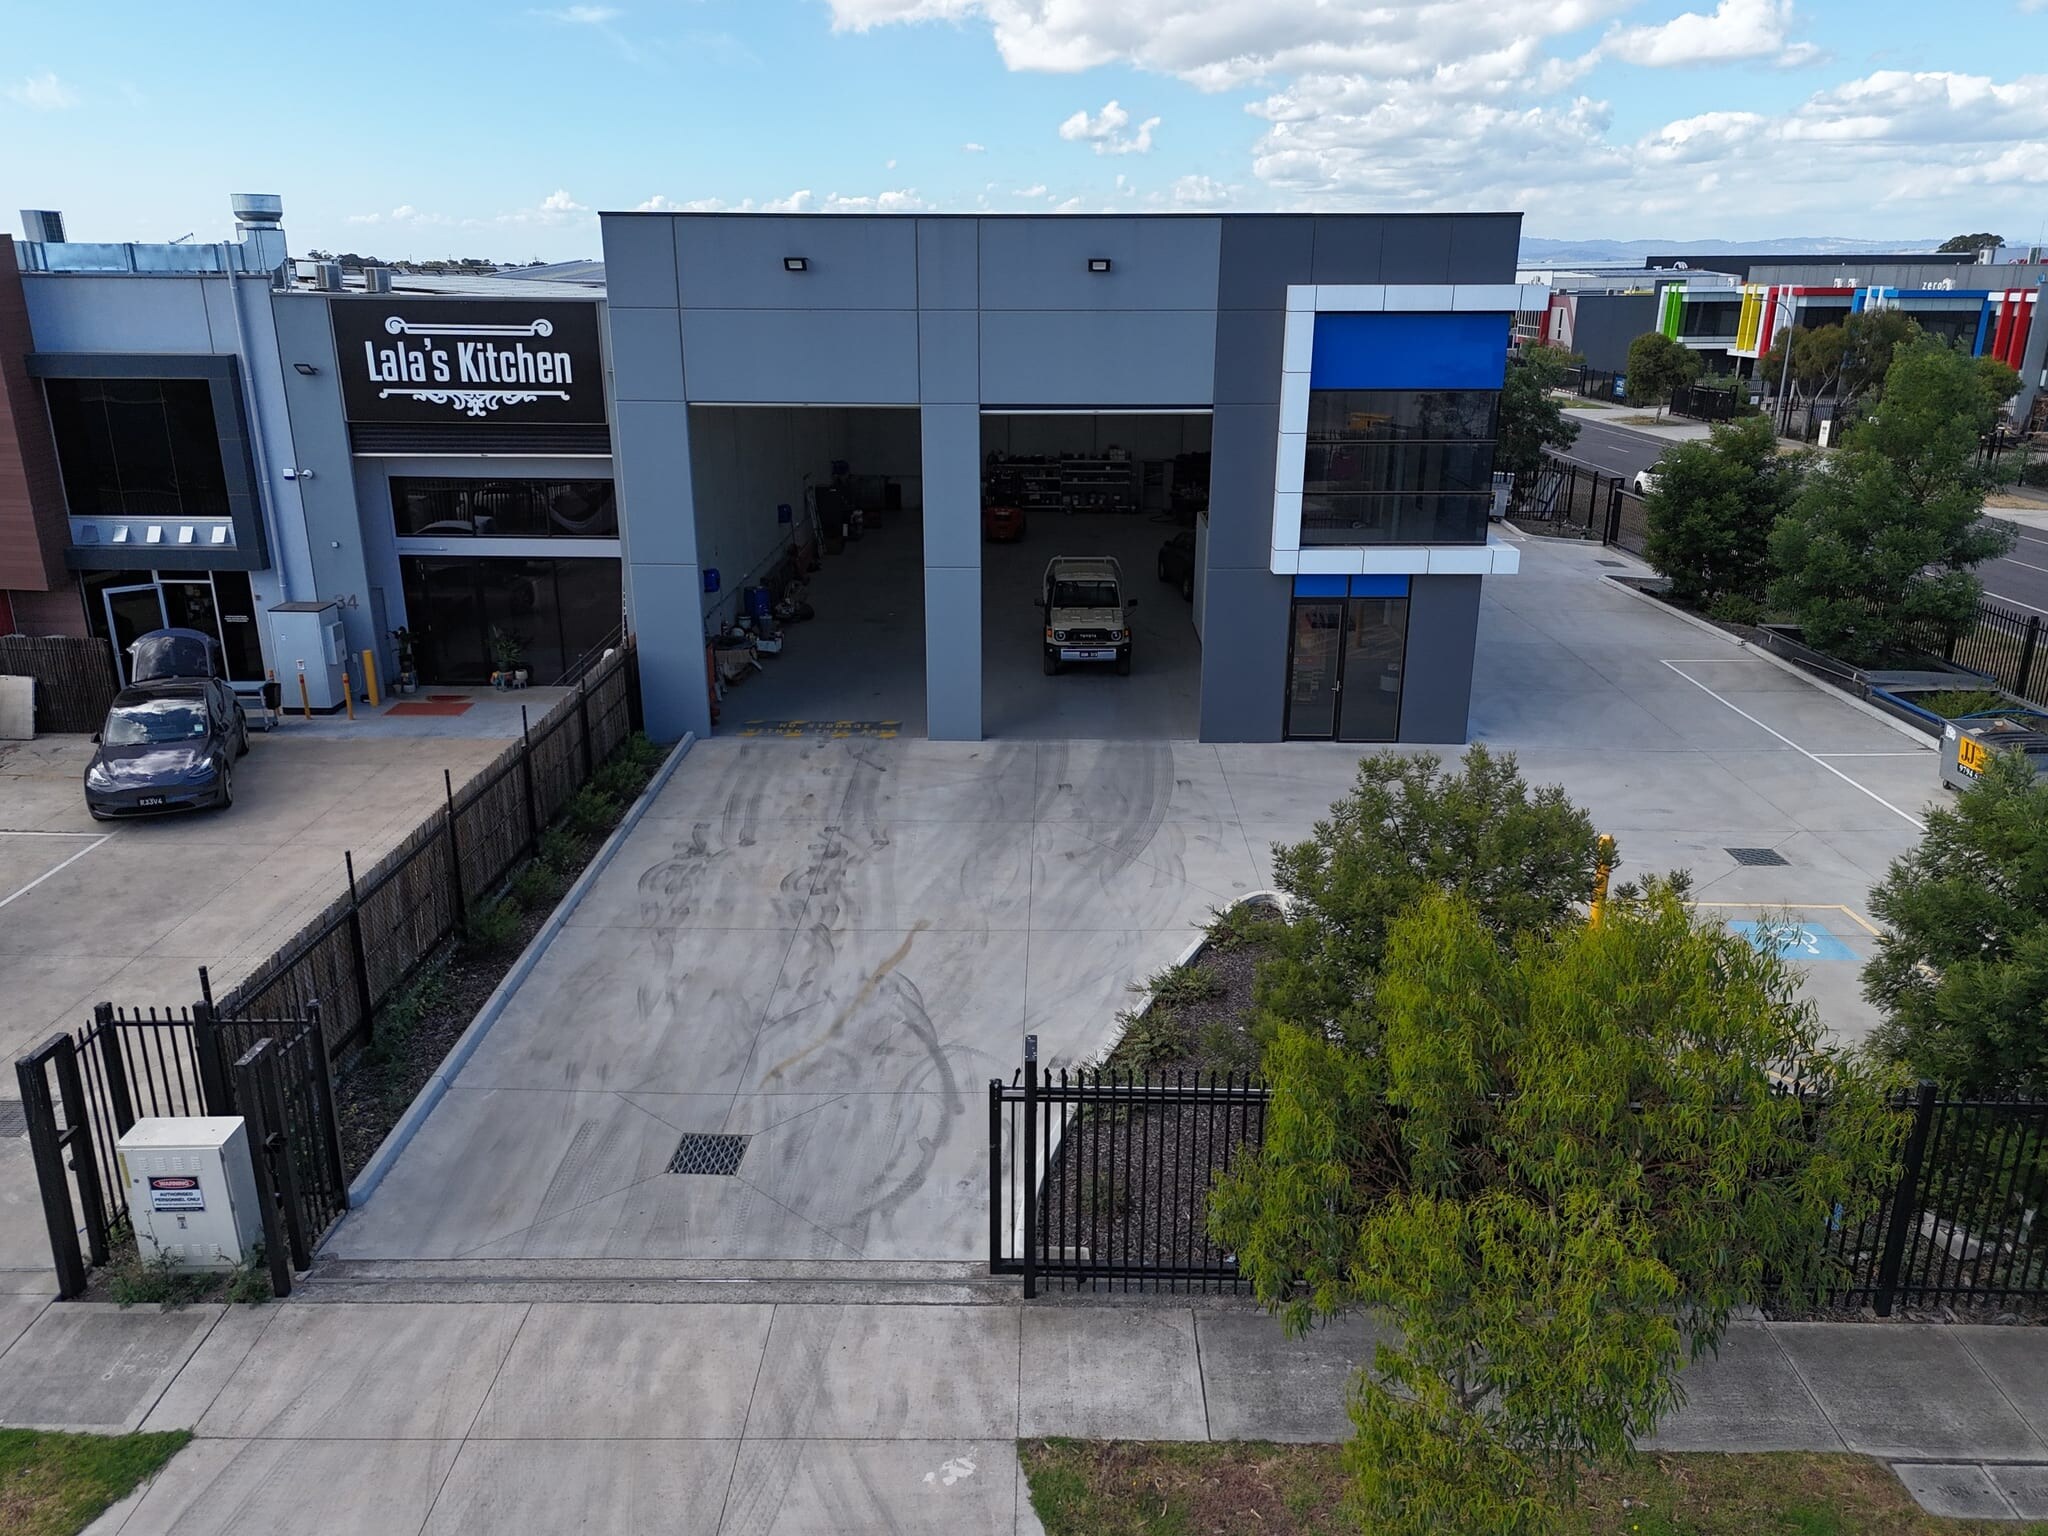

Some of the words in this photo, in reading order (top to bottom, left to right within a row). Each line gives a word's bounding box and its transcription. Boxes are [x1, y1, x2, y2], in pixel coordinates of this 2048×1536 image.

[365, 338, 450, 382] Lala's
[457, 341, 573, 384] Kitchen
[335, 594, 359, 610] 34
